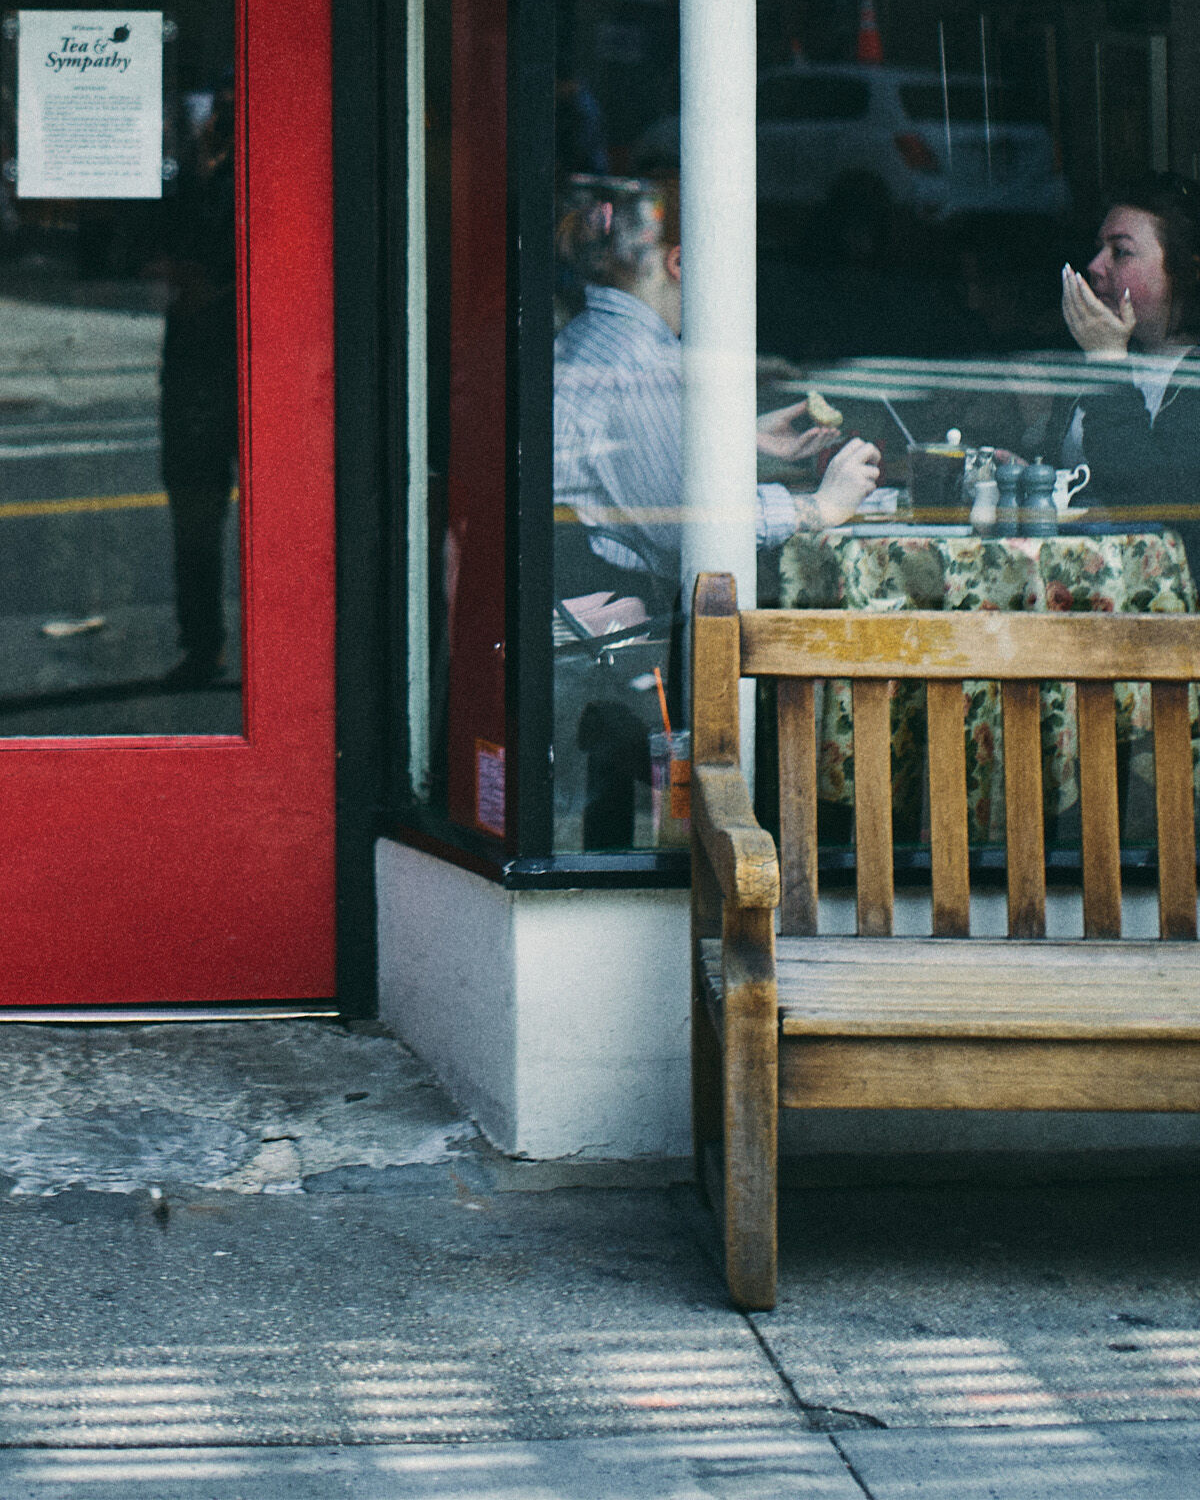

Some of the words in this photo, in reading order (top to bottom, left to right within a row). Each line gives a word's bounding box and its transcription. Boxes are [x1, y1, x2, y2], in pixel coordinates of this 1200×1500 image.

[61, 37, 88, 52] Tea
[94, 38, 109, 54] &
[45, 51, 131, 72] Sympathy
